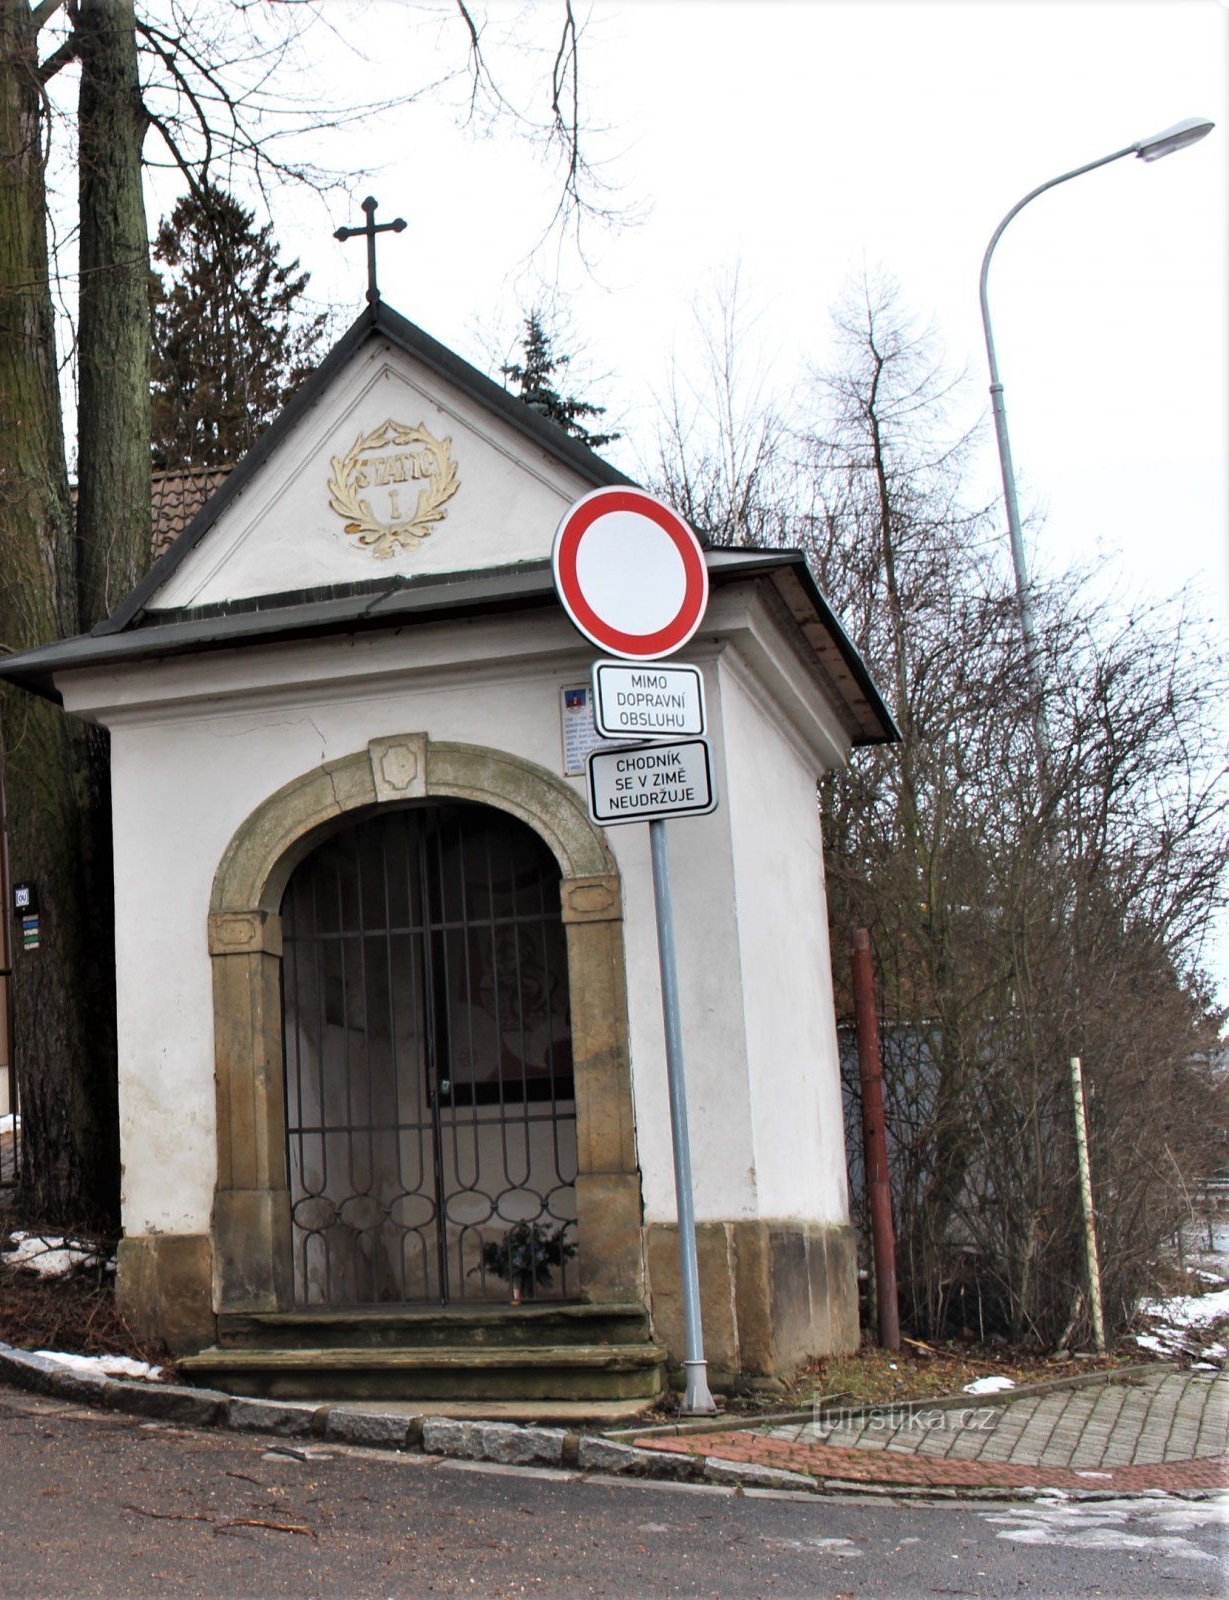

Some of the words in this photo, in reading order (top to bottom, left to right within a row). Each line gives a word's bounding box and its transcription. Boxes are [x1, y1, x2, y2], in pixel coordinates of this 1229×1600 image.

[631, 674, 667, 689] MIMO
[617, 691, 686, 709] DOPRAVNÍ
[620, 711, 685, 727] OBSLUHU
[616, 750, 682, 773] CHODNÍK
[615, 777, 633, 791] SE
[638, 775, 647, 788] V
[653, 767, 687, 786] ZIMĚ
[609, 787, 695, 810] NEUDRŽUJE
